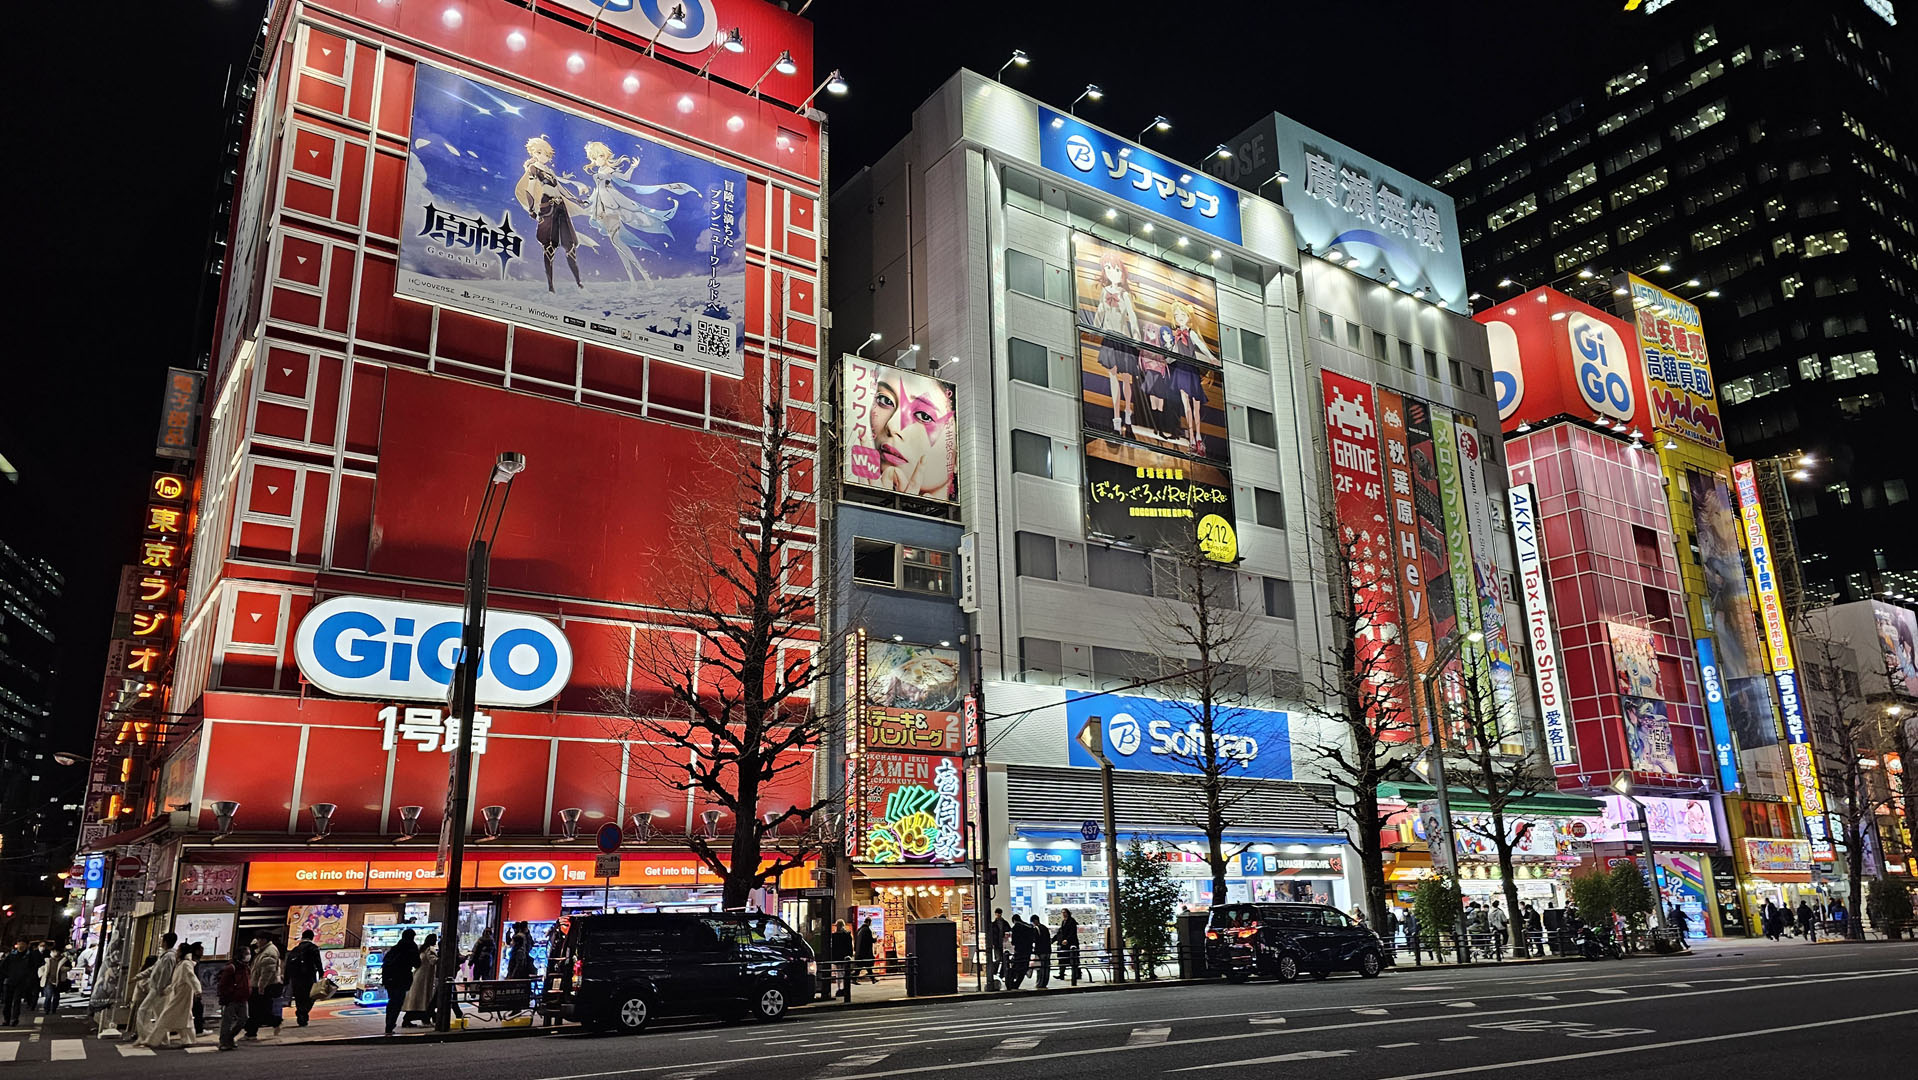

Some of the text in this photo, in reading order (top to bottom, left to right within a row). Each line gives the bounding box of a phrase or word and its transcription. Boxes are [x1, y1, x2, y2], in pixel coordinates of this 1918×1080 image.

[1101, 150, 1219, 218] ソフマップ
[723, 180, 735, 248] 冒険に満ちた
[417, 201, 523, 280] 原神
[427, 246, 488, 268] Genshin
[708, 189, 721, 312] ブランニューワールドへ
[528, 307, 558, 321] Windows
[1640, 310, 1705, 361] 激安販売
[1644, 347, 1712, 395] 高額買取
[852, 364, 867, 442] ワクワク
[1651, 387, 1724, 442] Mulan
[1665, 420, 1684, 433] ムーラン
[1333, 438, 1378, 476] GAME
[1335, 474, 1381, 500] 2F 4F
[1436, 427, 1467, 571] メロンブックス
[1511, 490, 1536, 548] AKKY
[1524, 564, 1549, 651] Tax-free
[1537, 652, 1558, 707] Shop
[312, 610, 558, 691] GiGO
[1702, 664, 1722, 704] GiGO
[871, 727, 944, 748] ハンバーグ
[945, 714, 960, 750] 2F
[1148, 719, 1259, 769] Sofmap
[866, 760, 929, 779] AMEN
[1082, 825, 1098, 835] 437
[295, 868, 446, 881] Get into the Gaming Oas
[502, 865, 552, 880] GiGO
[644, 867, 662, 876] Get
[662, 866, 680, 876] into
[681, 866, 696, 876] the
